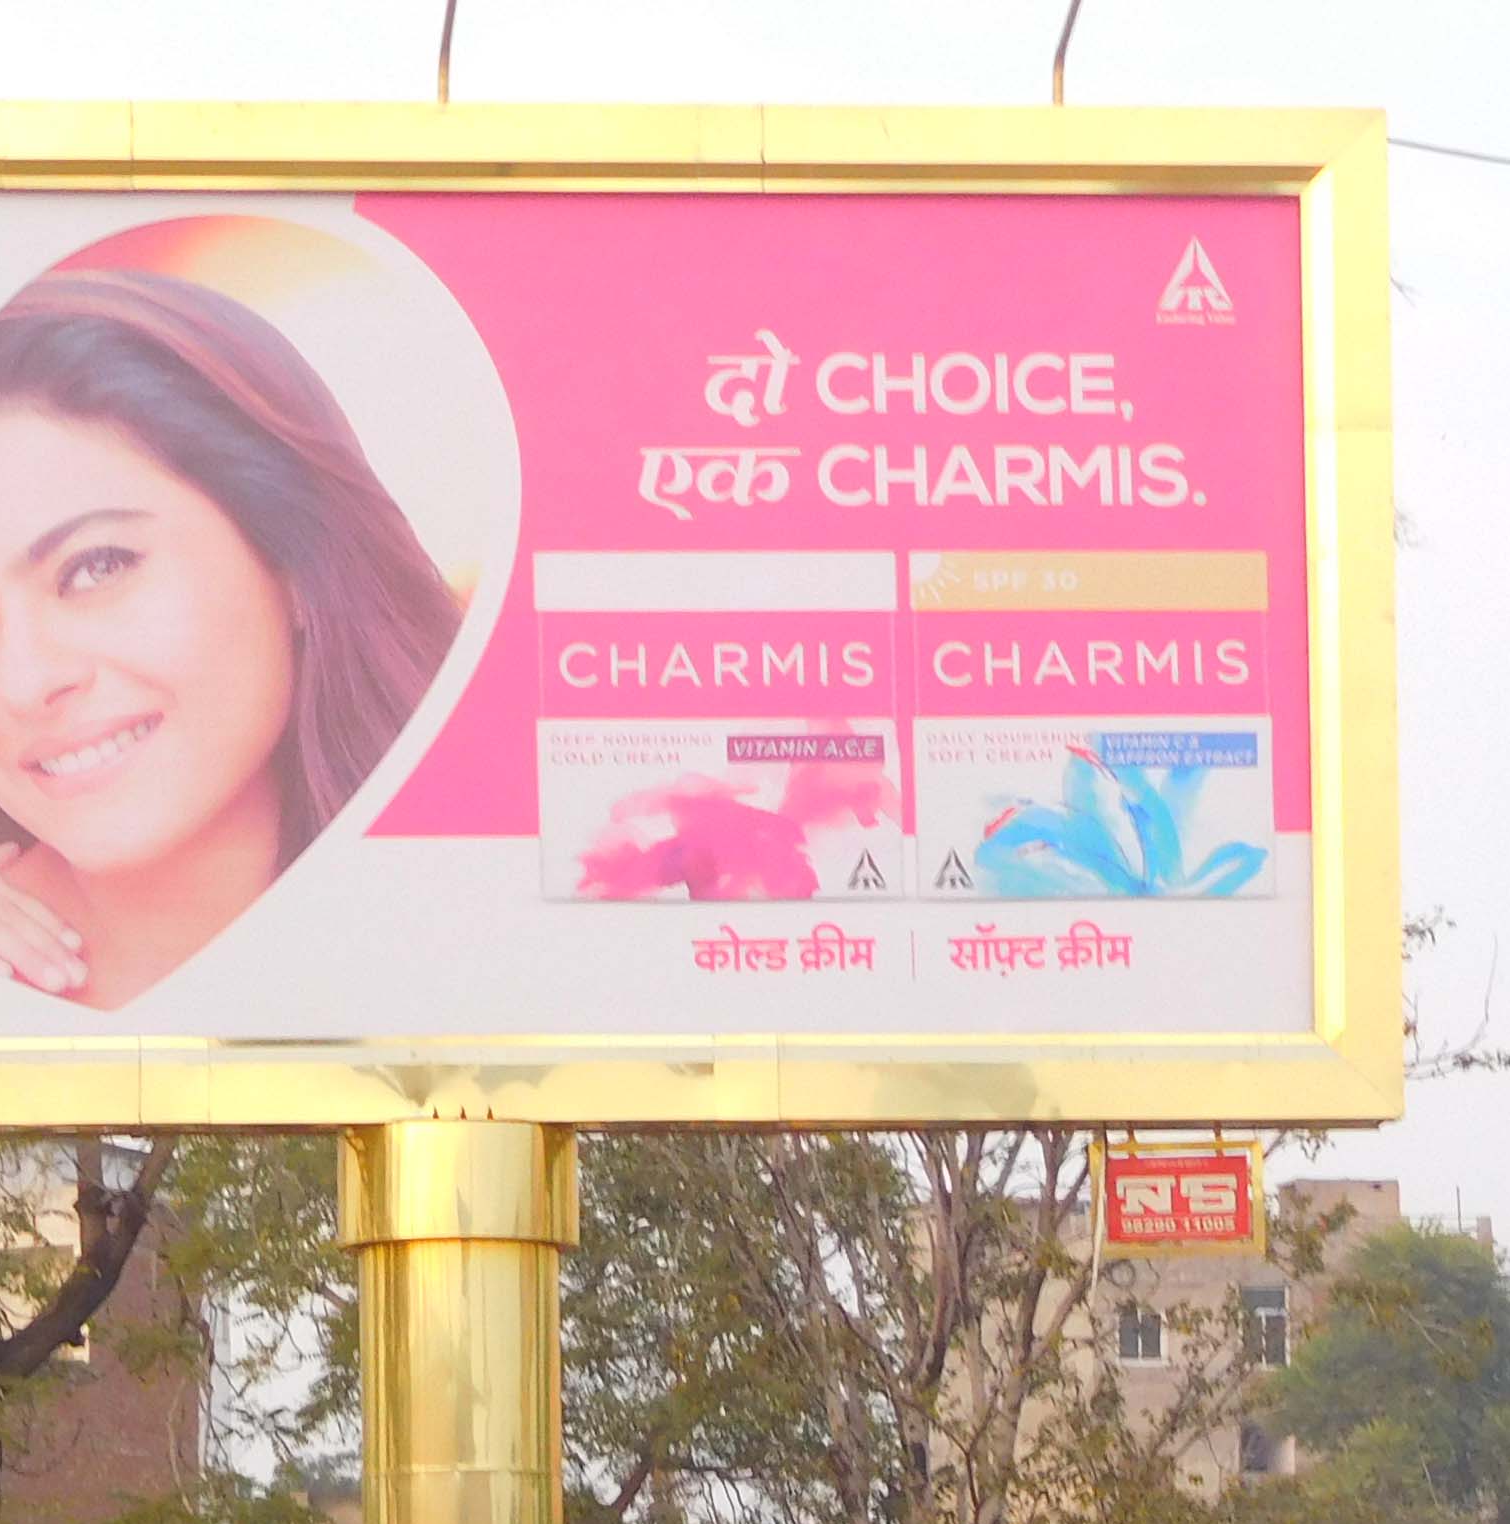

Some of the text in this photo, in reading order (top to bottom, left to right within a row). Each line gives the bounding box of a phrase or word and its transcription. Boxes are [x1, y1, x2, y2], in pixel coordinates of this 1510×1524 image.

[703, 329, 1135, 427] दो CHOICE,
[636, 443, 1208, 522] एक CHARMIS.
[559, 641, 876, 689] CHARMIS
[932, 639, 1251, 687] CHARMIS
[732, 740, 818, 759] VITAMIN
[691, 922, 876, 974] कोल्ड क्रीम
[1055, 919, 1133, 971] क्रीम
